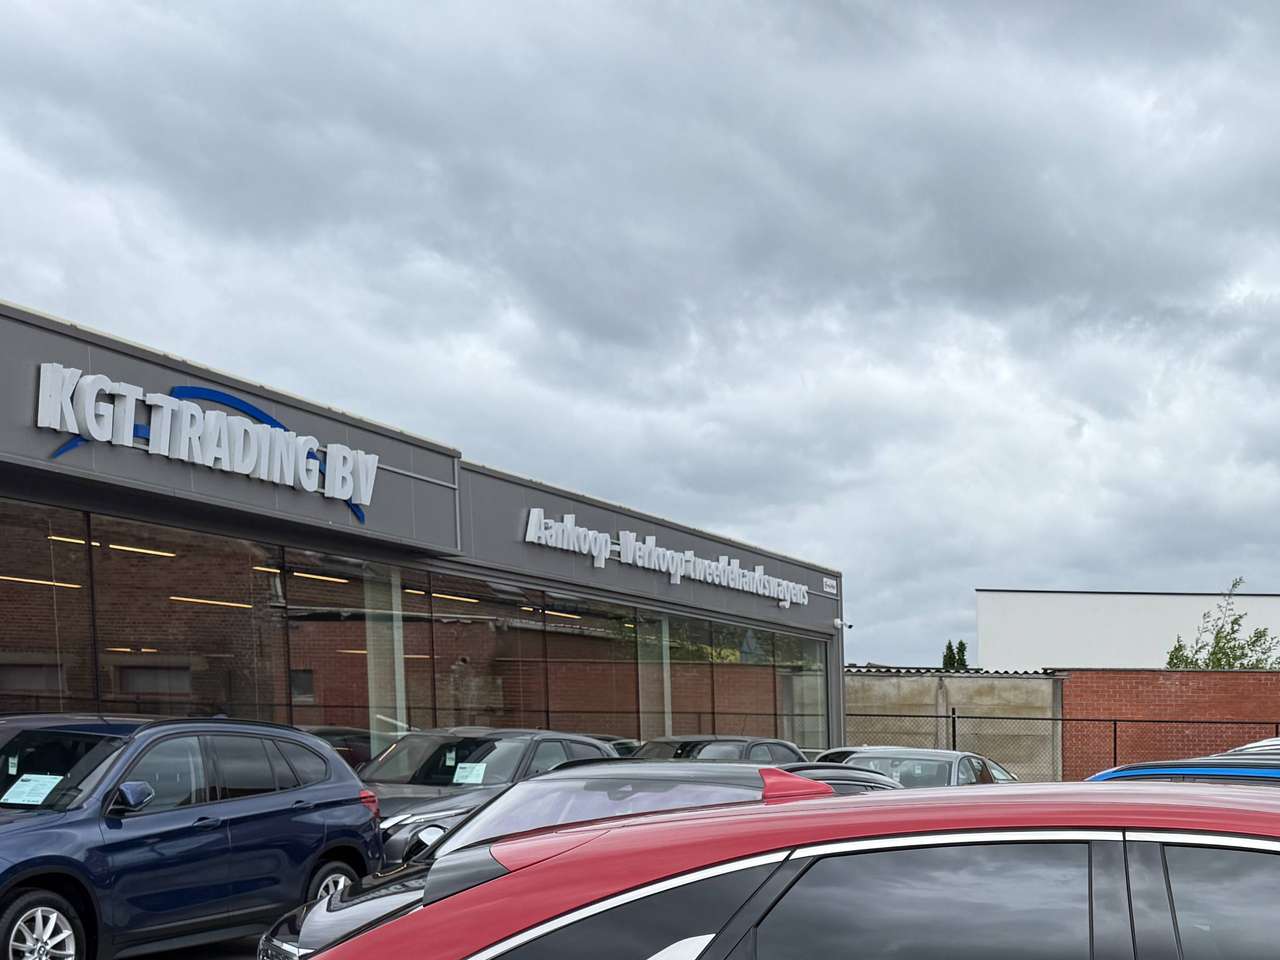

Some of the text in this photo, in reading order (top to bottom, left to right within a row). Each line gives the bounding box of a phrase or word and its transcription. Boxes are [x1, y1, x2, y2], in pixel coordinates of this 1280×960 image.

[37, 362, 379, 506] KGT TRADING BV
